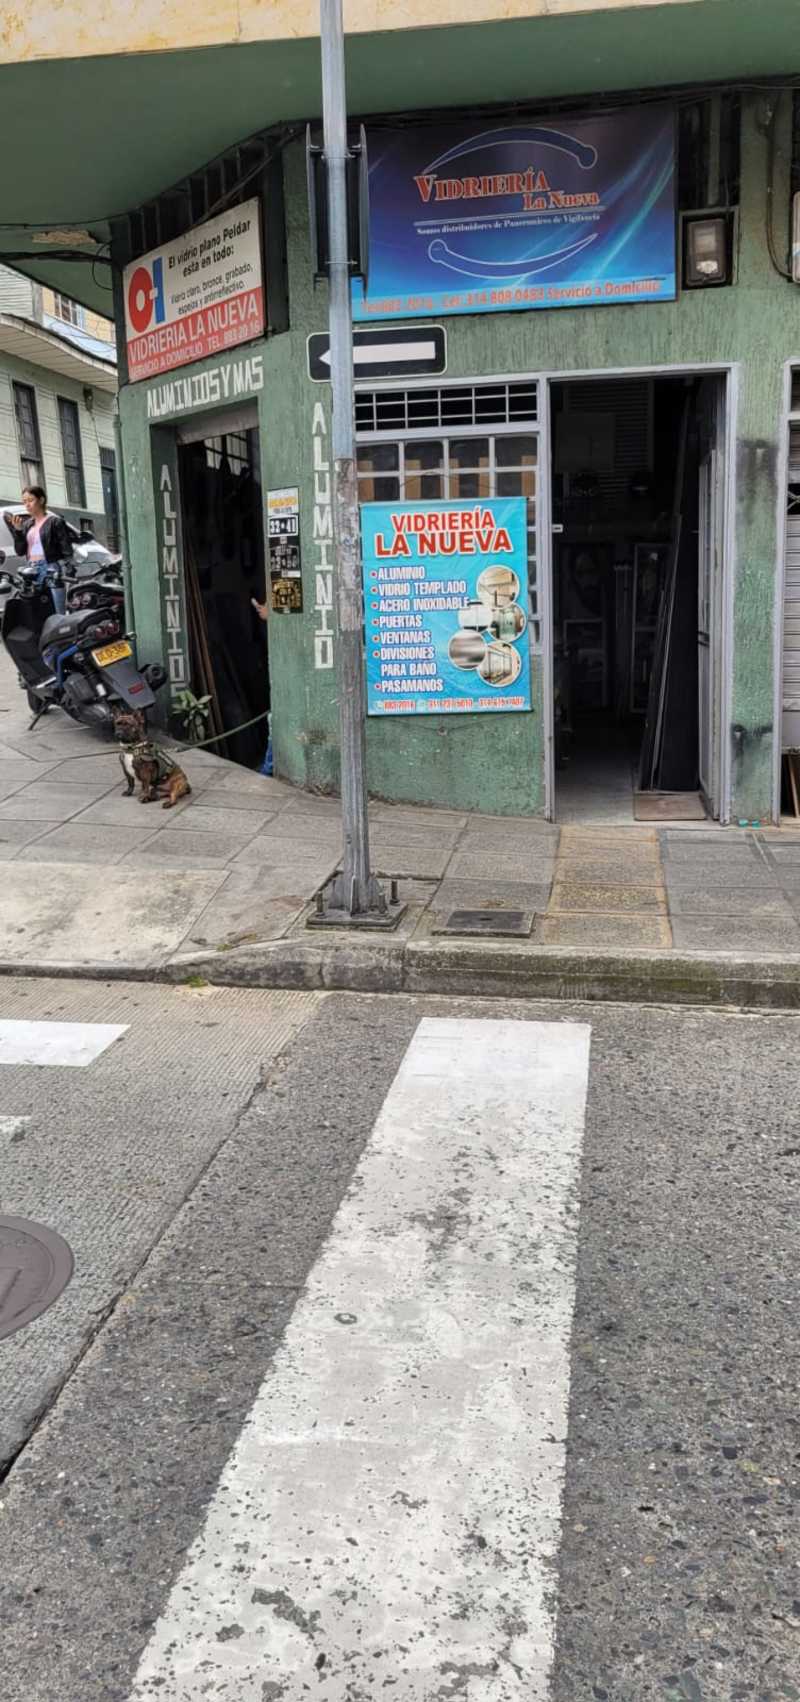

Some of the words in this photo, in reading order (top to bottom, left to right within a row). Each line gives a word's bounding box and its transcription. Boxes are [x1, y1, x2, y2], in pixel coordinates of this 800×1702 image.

[523, 193, 546, 210] La
[548, 190, 600, 208] Nueva
[168, 256, 176, 269] El
[177, 246, 197, 265] vidrio
[199, 234, 221, 257] plano
[223, 220, 250, 241] Peldar
[183, 261, 200, 277] esta
[201, 256, 211, 269] en
[213, 245, 234, 263] todo:
[547, 284, 592, 301] Servicio
[129, 327, 188, 364] VIDRIERIA
[188, 313, 206, 341] LA
[207, 292, 259, 334] NUEVA
[146, 367, 221, 418] ALUMINIOS
[221, 363, 231, 398] Y
[232, 355, 264, 397] MAS
[392, 506, 496, 533] VIDRIERÍA
[311, 402, 335, 669] ALUMINIO
[375, 532, 412, 558] LA
[417, 528, 513, 556] NUEVA
[377, 567, 426, 580] ALUMINIO
[378, 583, 411, 597] VIDRIO
[413, 581, 467, 595] TEMPLADO
[379, 599, 411, 612] ACERO
[413, 596, 469, 610] INOXIDABLE
[379, 614, 423, 628] PUERTAS
[380, 630, 431, 644] VENTANAS
[380, 647, 434, 661] DIVISIONES
[381, 663, 407, 677] PARA
[382, 680, 443, 693] PASAMANOS
